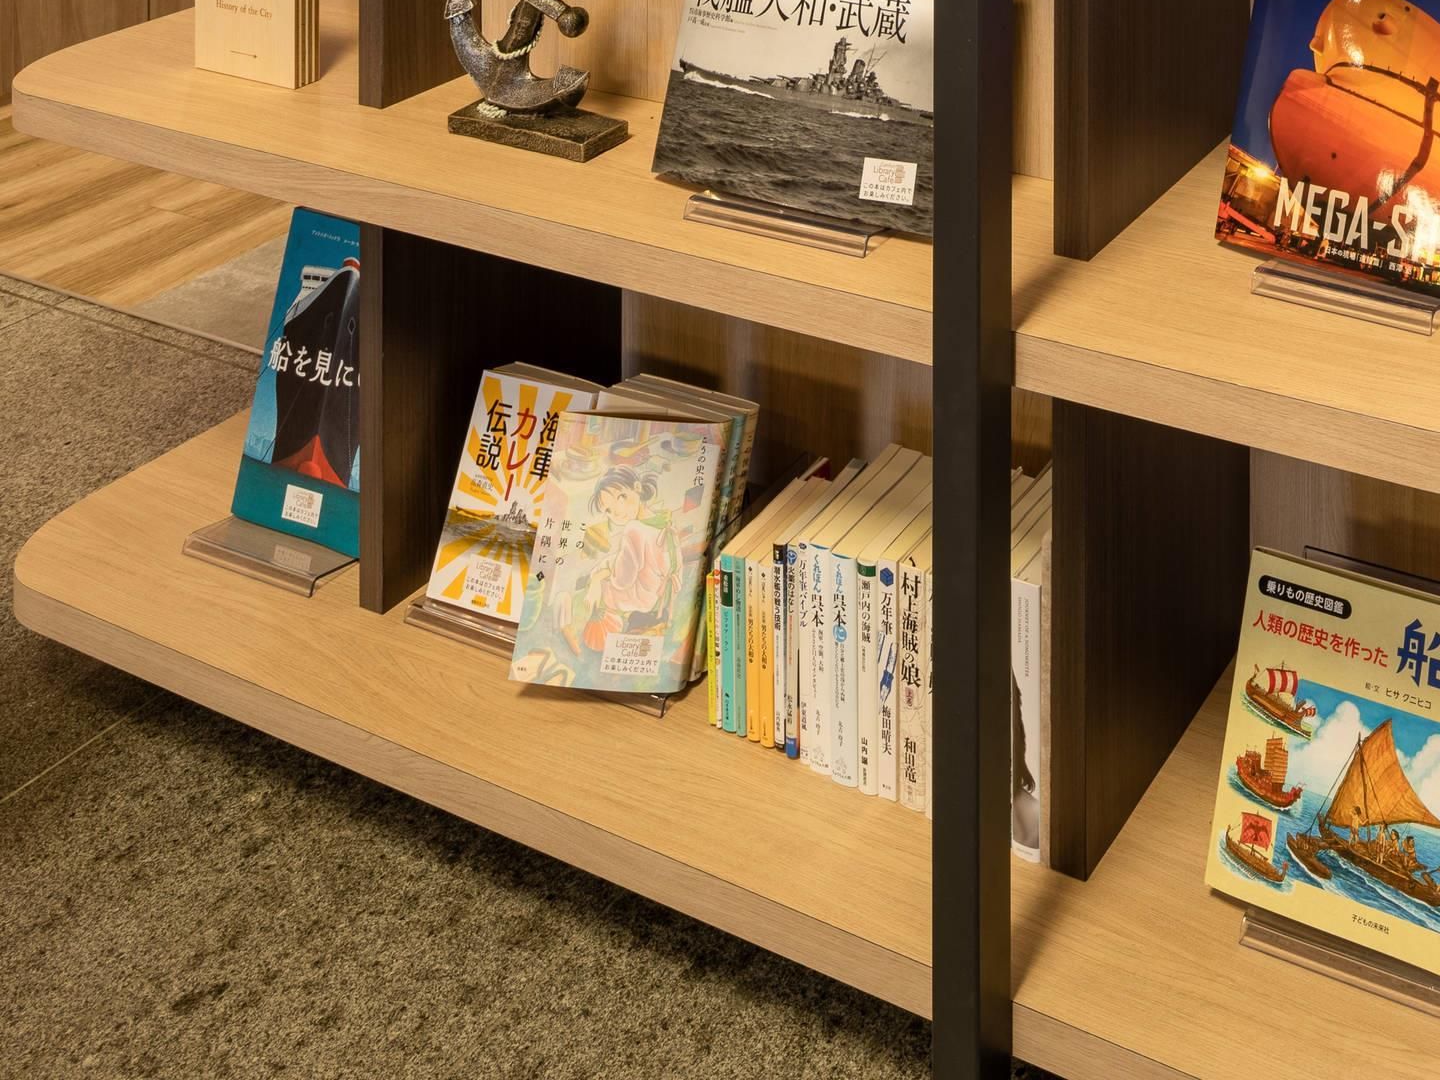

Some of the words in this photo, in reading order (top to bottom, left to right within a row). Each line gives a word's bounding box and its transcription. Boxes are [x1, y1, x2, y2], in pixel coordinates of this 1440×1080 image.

[216, 0, 238, 14] History
[240, 4, 246, 13] of
[248, 6, 258, 16] the
[268, 336, 360, 387] 船を見に
[476, 399, 512, 471] 伝説
[505, 408, 537, 501] カレー
[693, 436, 707, 487] こうの史代
[800, 559, 808, 628] 万年筆バイブル
[861, 580, 870, 643] 瀬戸内の海賊
[881, 592, 893, 635] 万年筆
[1266, 580, 1345, 615] 乗りもの歴史図鑑
[616, 640, 640, 650] Library
[621, 648, 639, 658] Cafe
[901, 572, 922, 688] 村上海賊の娘
[1253, 609, 1389, 668] 人類の歴史を作った
[1385, 687, 1400, 699] ヒサ
[1402, 693, 1432, 710] クニヒコ
[881, 705, 892, 755] 梅田晴夫
[904, 737, 917, 784] 和田竜
